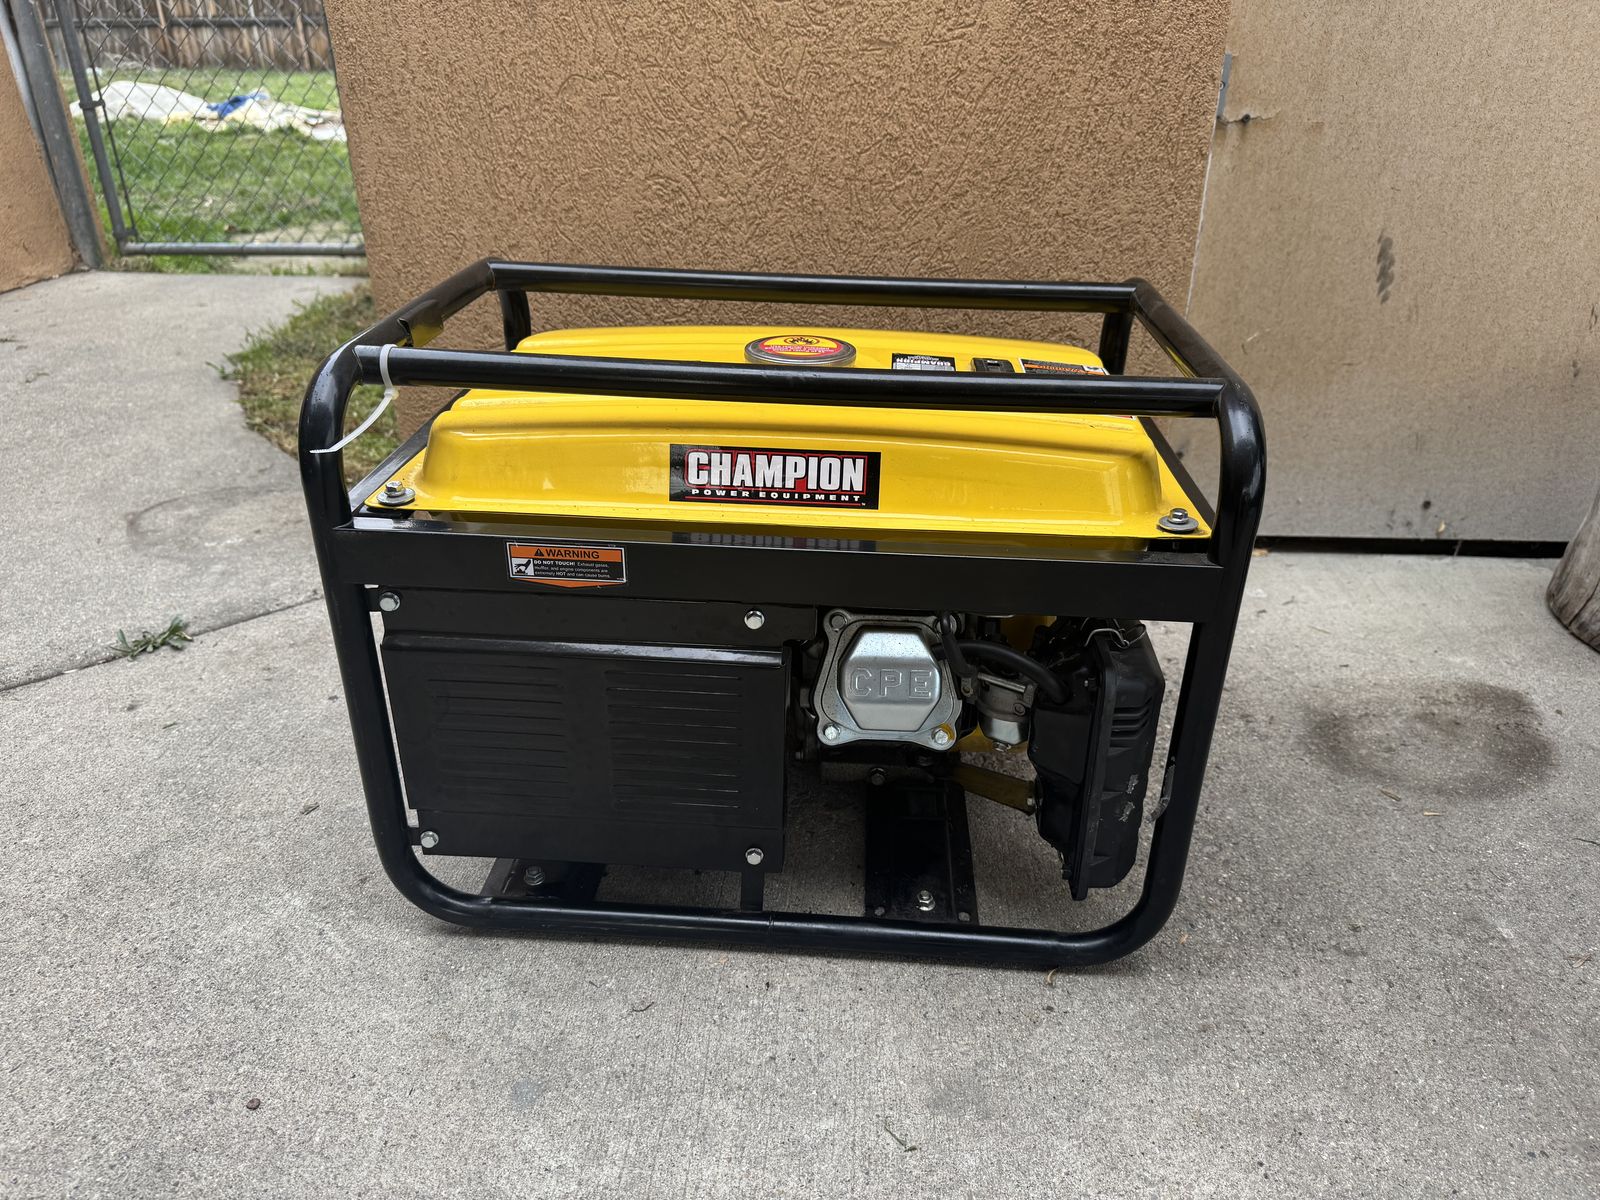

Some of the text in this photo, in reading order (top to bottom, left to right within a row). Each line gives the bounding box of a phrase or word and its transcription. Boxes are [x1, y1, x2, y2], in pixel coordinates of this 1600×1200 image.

[688, 452, 864, 491] CHAMPION
[692, 488, 860, 502] POWER EQUIPMENT
[546, 548, 600, 559] WARNING
[849, 667, 932, 699] CPE
